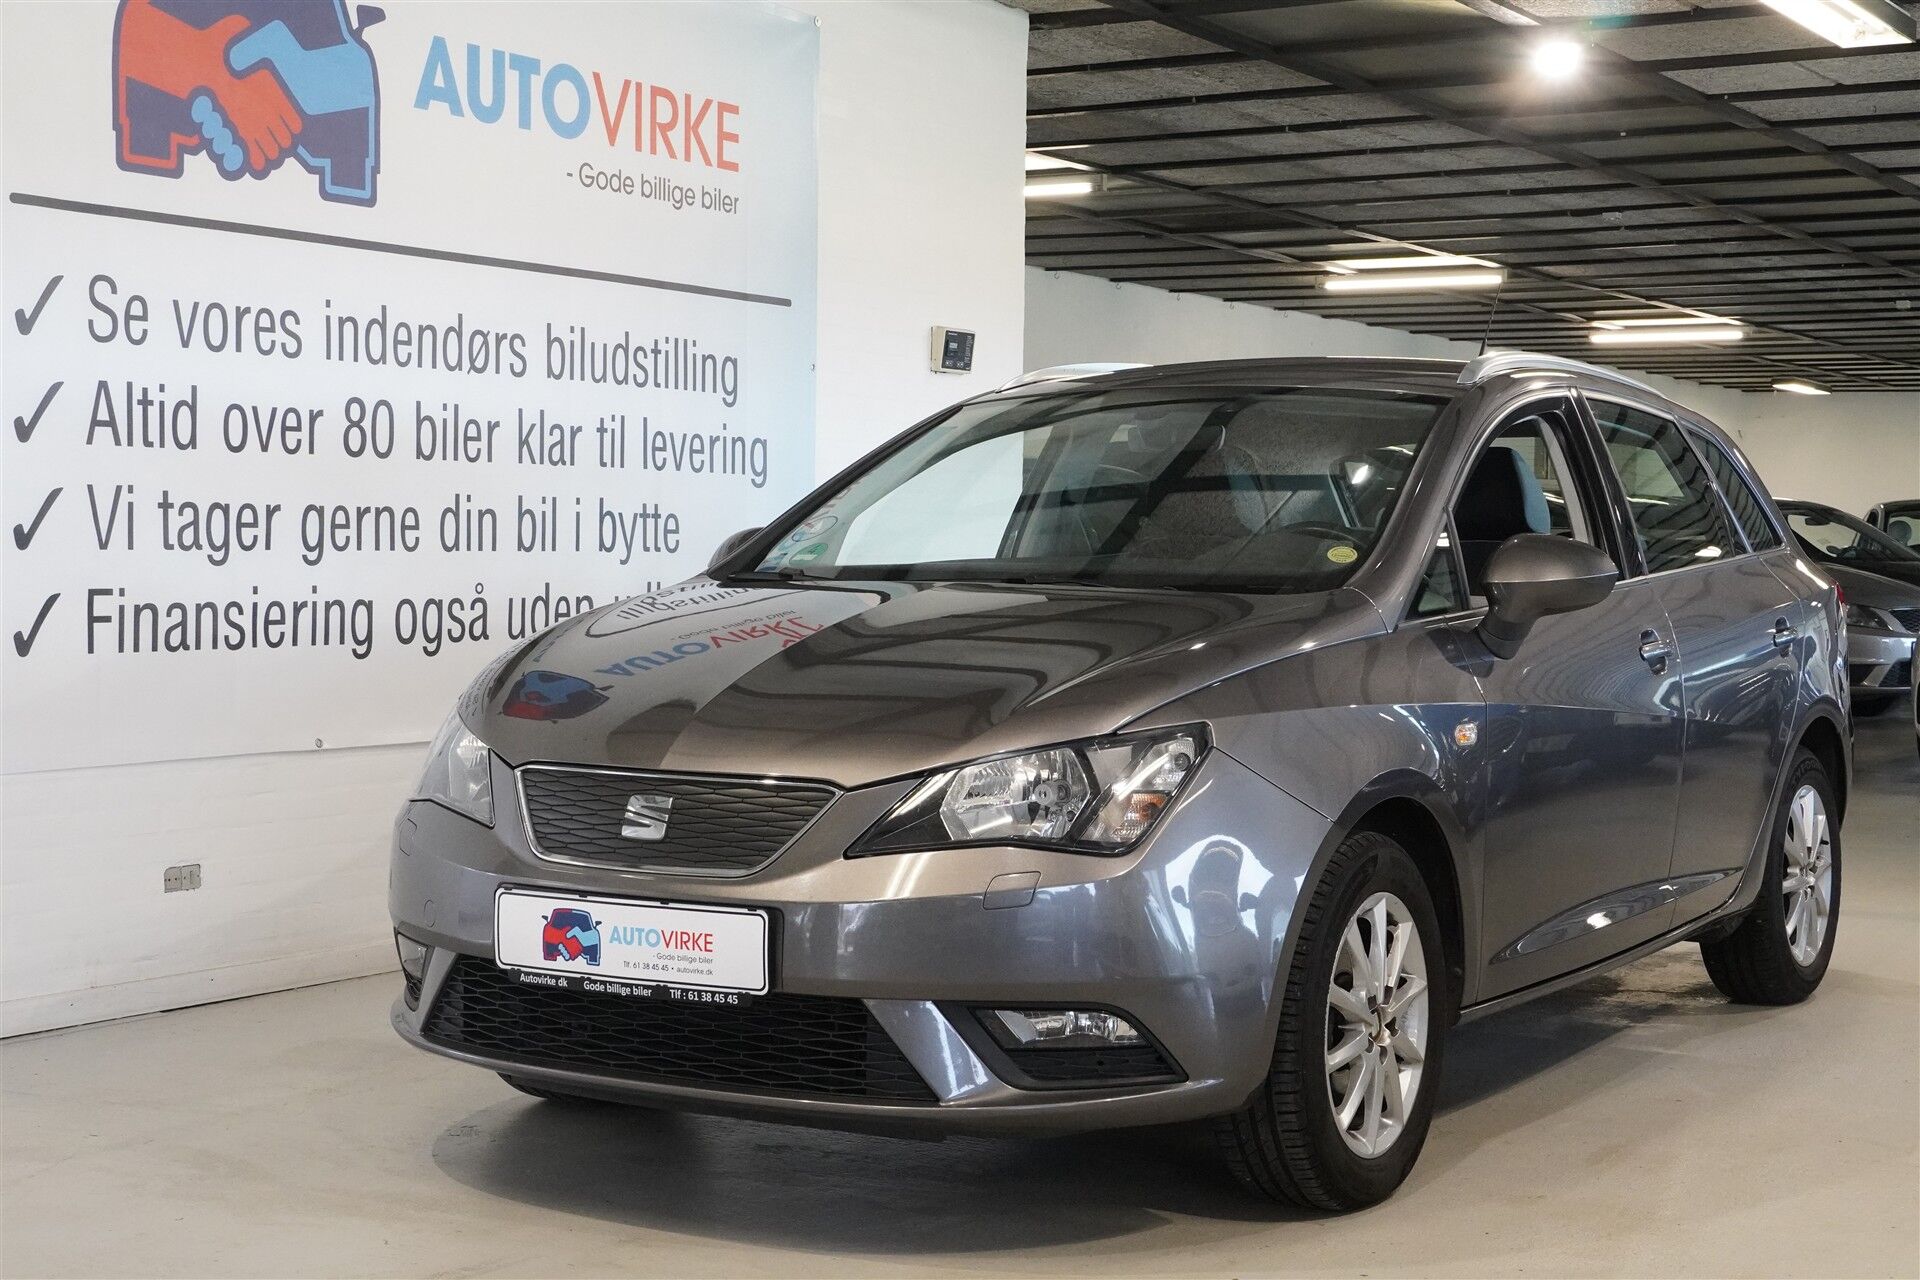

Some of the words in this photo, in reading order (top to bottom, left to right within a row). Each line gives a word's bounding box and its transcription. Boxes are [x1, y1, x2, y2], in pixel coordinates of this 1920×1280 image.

[414, 36, 741, 173] AUTOVIRKE
[579, 162, 634, 195] Gode
[641, 173, 695, 210] billige
[702, 182, 739, 214] biler
[88, 274, 149, 345] Se
[173, 299, 302, 359] vores
[326, 299, 527, 378] indendørs
[547, 323, 739, 408] biludstilling
[86, 380, 197, 451] Altid
[223, 405, 323, 455] over
[343, 397, 395, 459] 80
[416, 401, 500, 463] biler
[518, 408, 582, 466] klar
[597, 406, 626, 468] til
[643, 417, 768, 488] levering
[87, 484, 134, 550] Vi
[158, 490, 281, 566] tager
[301, 504, 420, 566] gerne
[440, 494, 497, 552] din
[517, 495, 559, 552] bil
[574, 497, 581, 552] i
[599, 497, 681, 565] bytte
[87, 585, 374, 661] Finansiering
[395, 582, 489, 657] også
[609, 926, 713, 952] AUTOVIRKE
[642, 962, 650, 970] 38
[651, 963, 660, 971] 45
[660, 964, 669, 972] 45
[676, 965, 713, 975] autovirke.dk
[656, 952, 676, 961] Gode
[677, 955, 697, 964] billige
[698, 956, 713, 964] biler
[520, 973, 556, 986] Autovirke
[558, 978, 568, 988] dk
[583, 980, 605, 992] Gode
[606, 983, 631, 996] billige
[632, 986, 652, 996] biler
[688, 991, 699, 1001] 61
[701, 992, 712, 1002] 38
[714, 993, 725, 1004] 45
[726, 994, 738, 1005] 45
